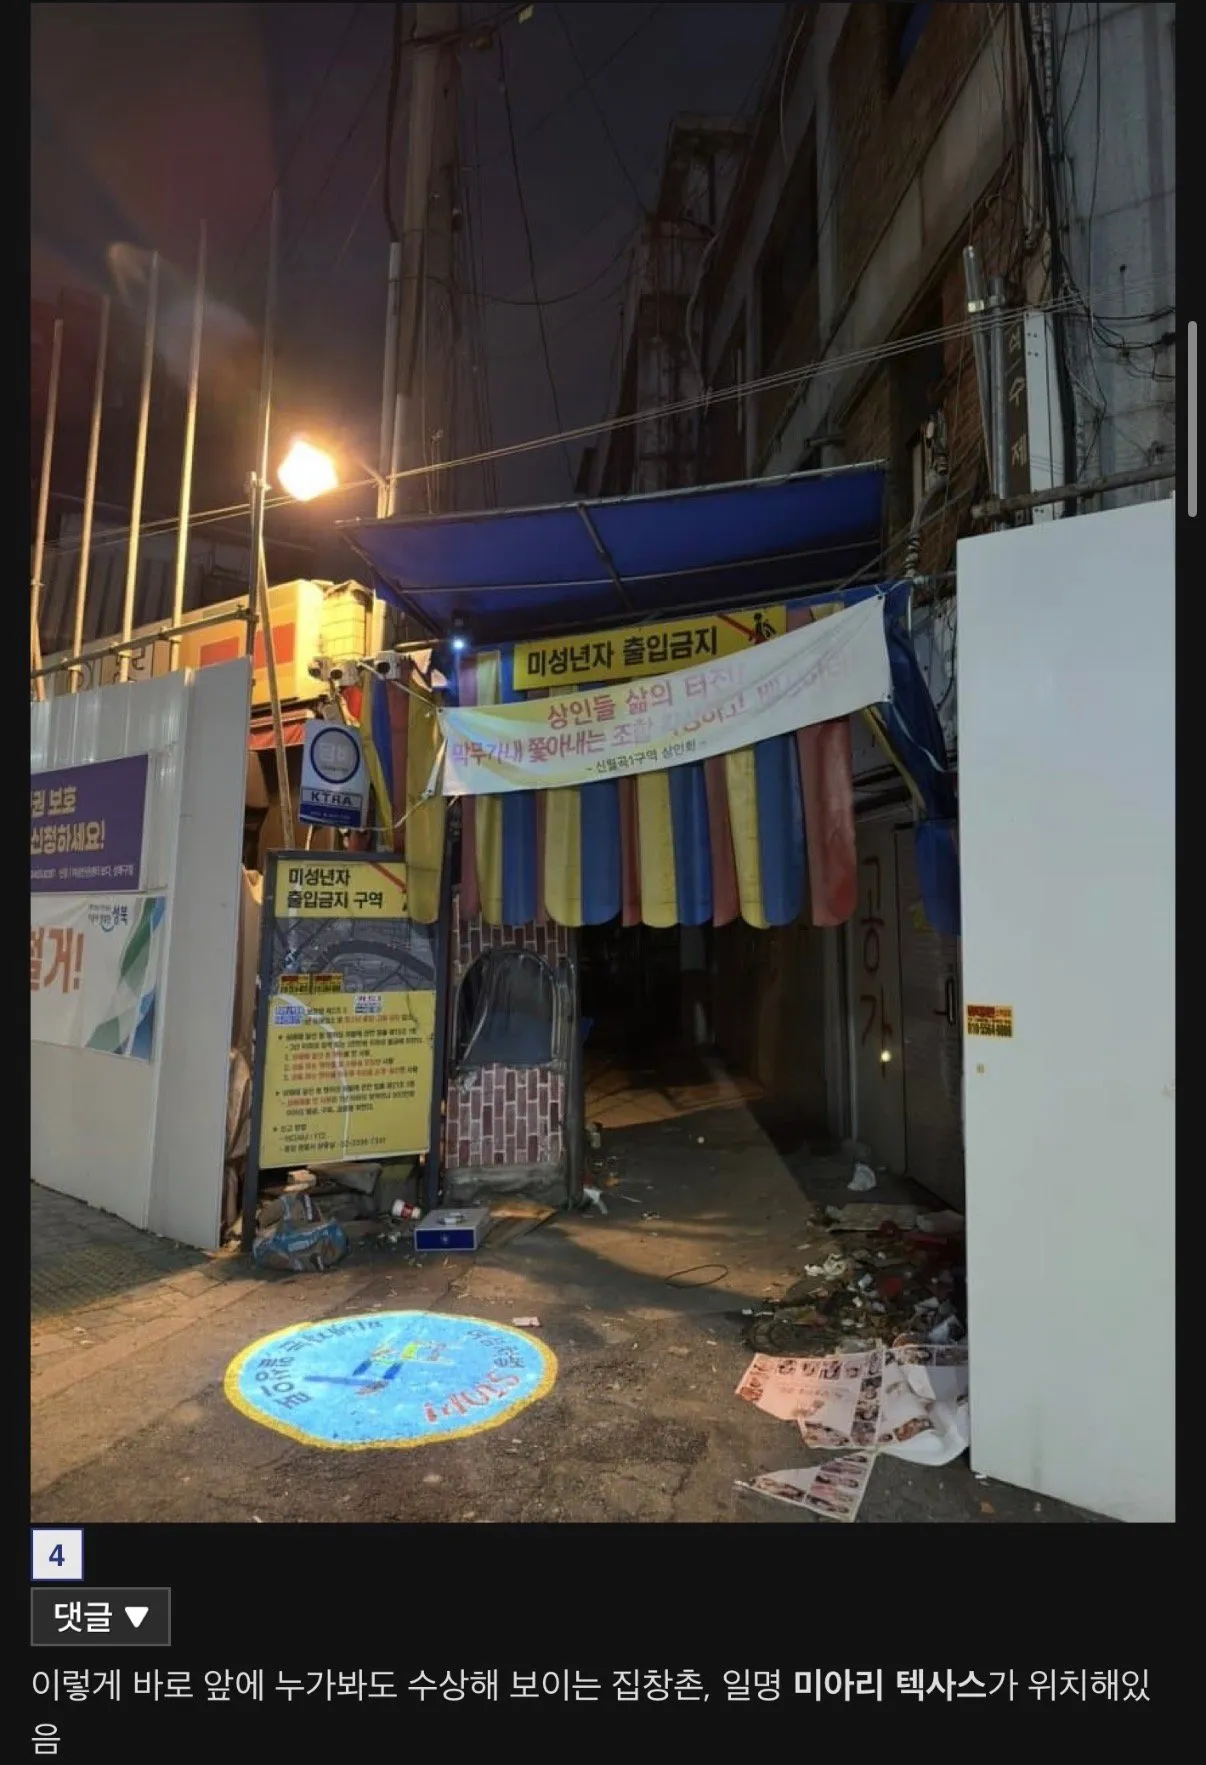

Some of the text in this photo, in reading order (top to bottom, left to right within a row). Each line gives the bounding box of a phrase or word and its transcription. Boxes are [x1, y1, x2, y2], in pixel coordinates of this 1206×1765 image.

[527, 626, 718, 677] 미성년자 출입금지
[547, 693, 616, 730] 상인들
[626, 680, 673, 714] 삶의
[528, 728, 606, 764] 쫓아내는
[47, 785, 77, 817] 보호
[288, 867, 350, 886] 미성년자
[287, 890, 384, 910] 출입금지 구역
